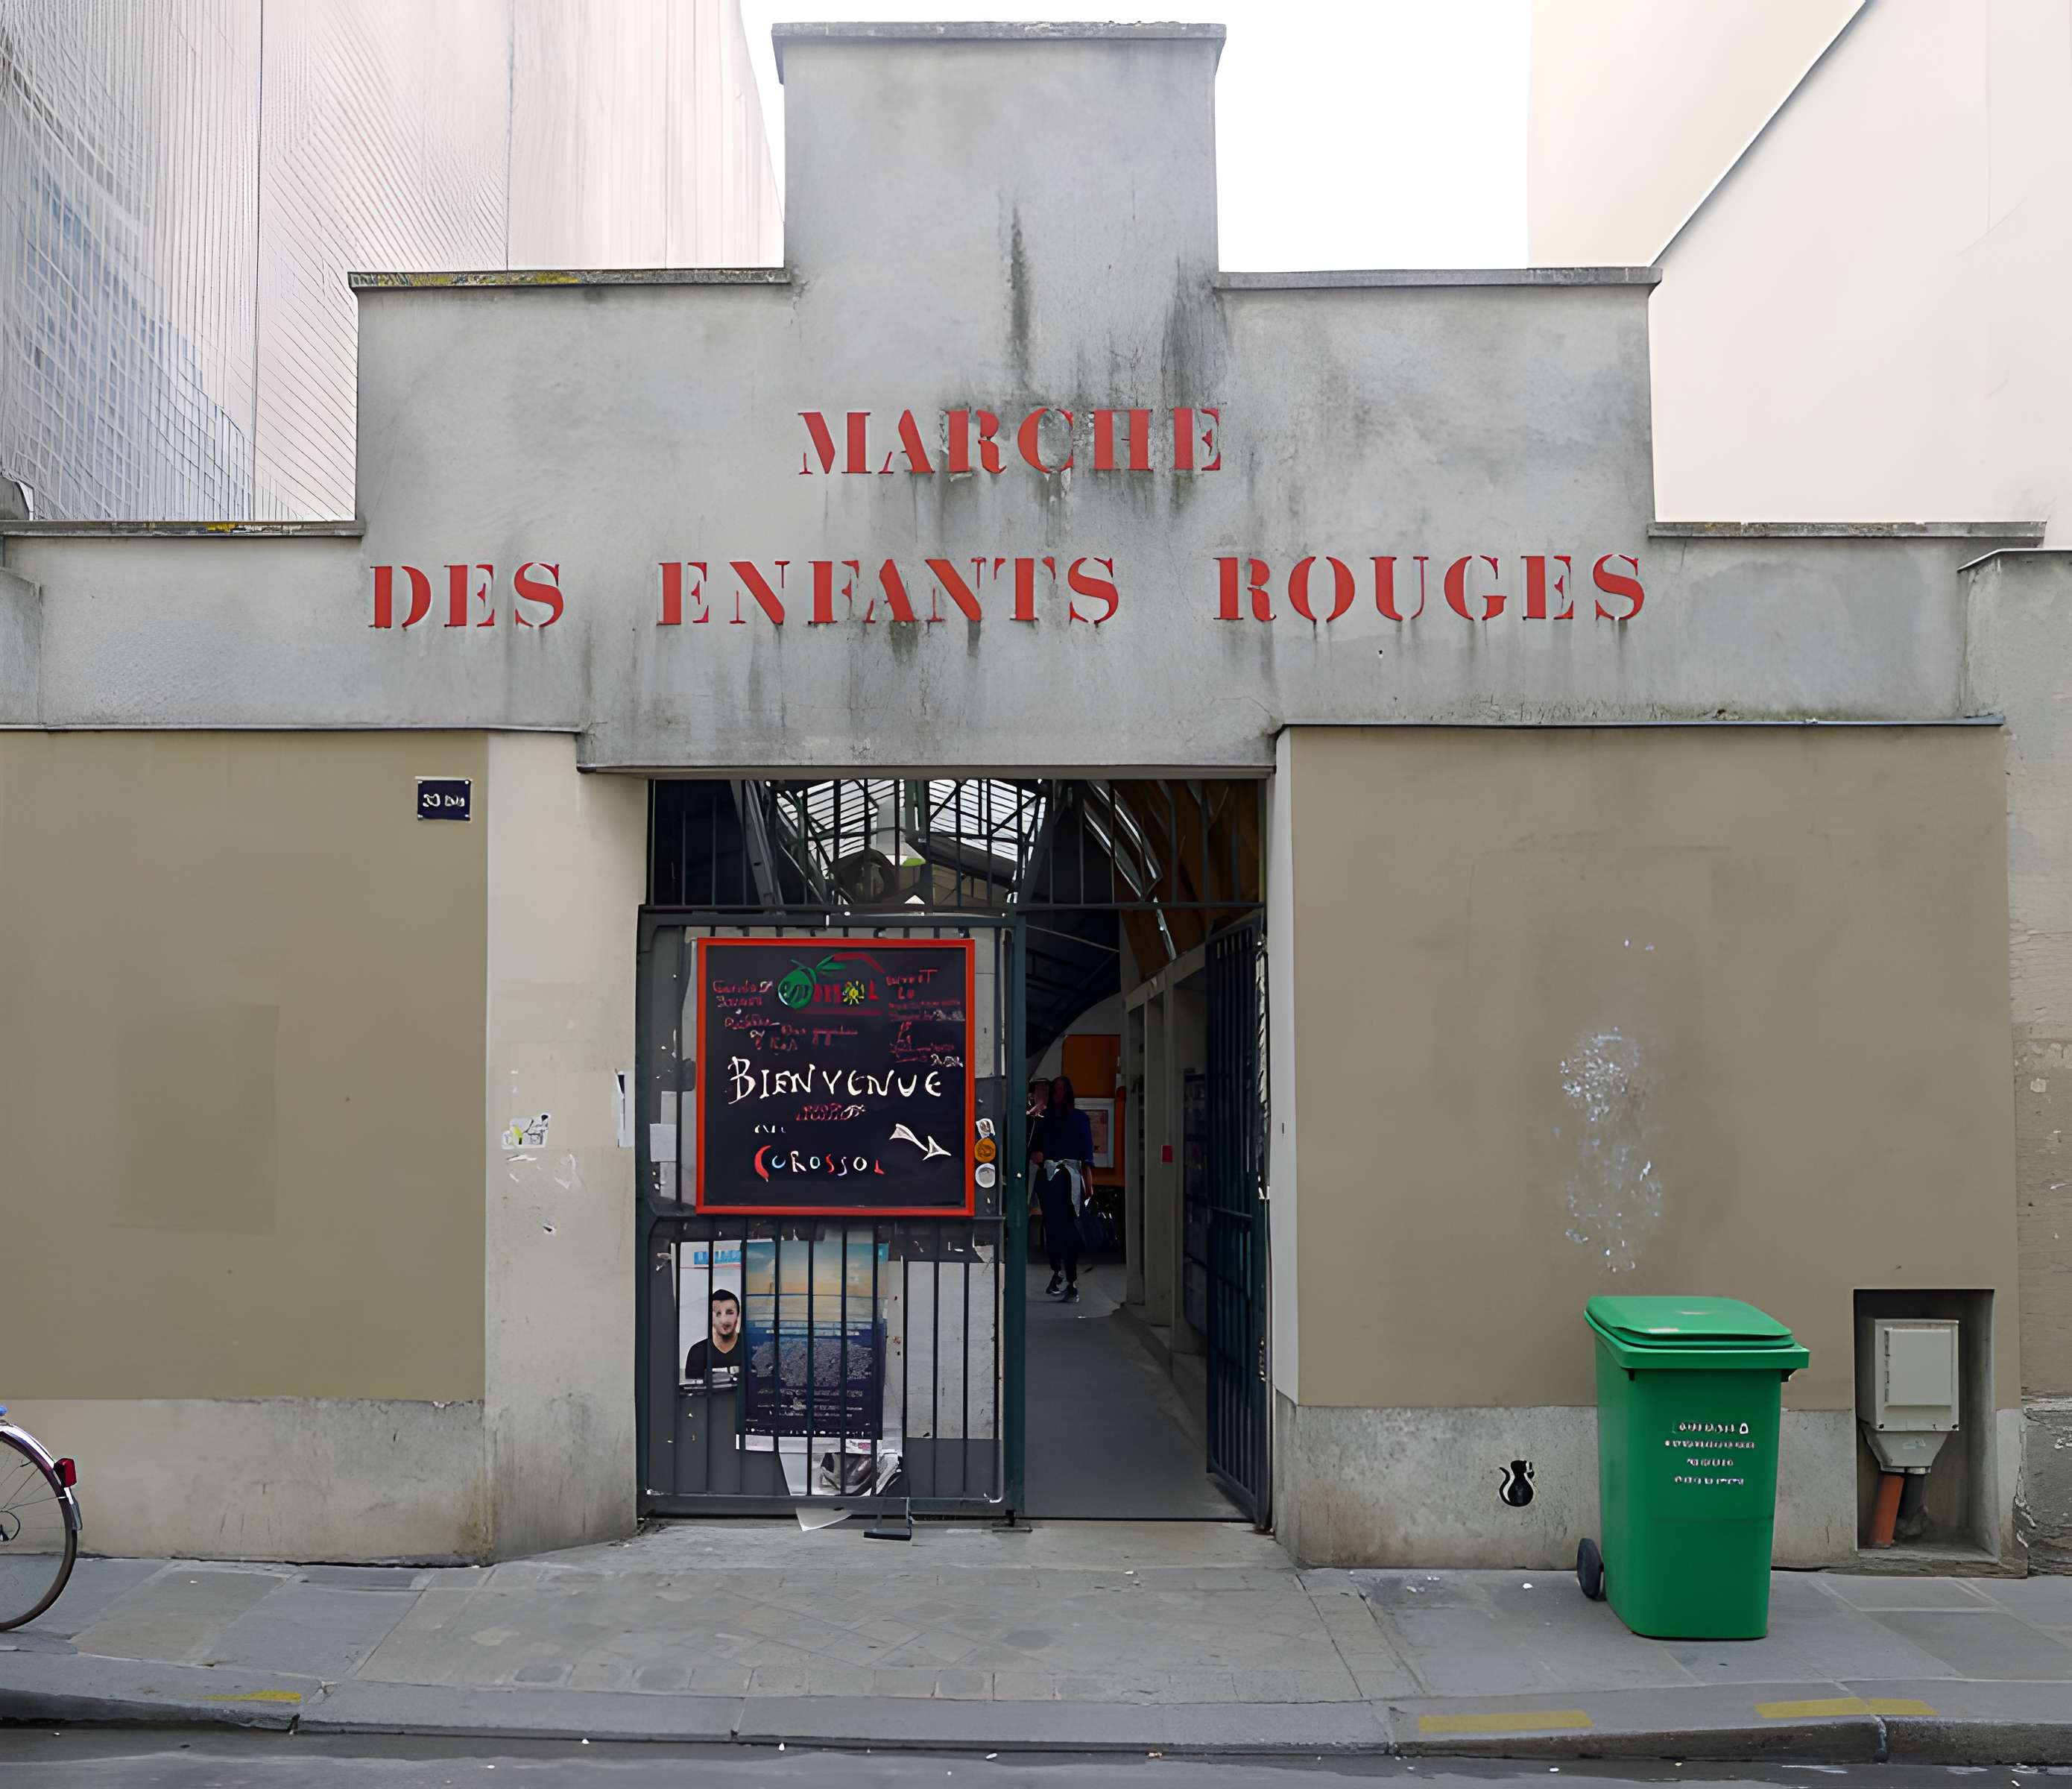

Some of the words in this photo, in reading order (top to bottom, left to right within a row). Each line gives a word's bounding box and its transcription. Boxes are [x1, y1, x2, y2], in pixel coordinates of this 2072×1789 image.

[797, 406, 1222, 476] MARCHE
[369, 561, 564, 630] DES
[657, 555, 1119, 627] ENFANTS
[1215, 552, 1645, 623] ROUGES
